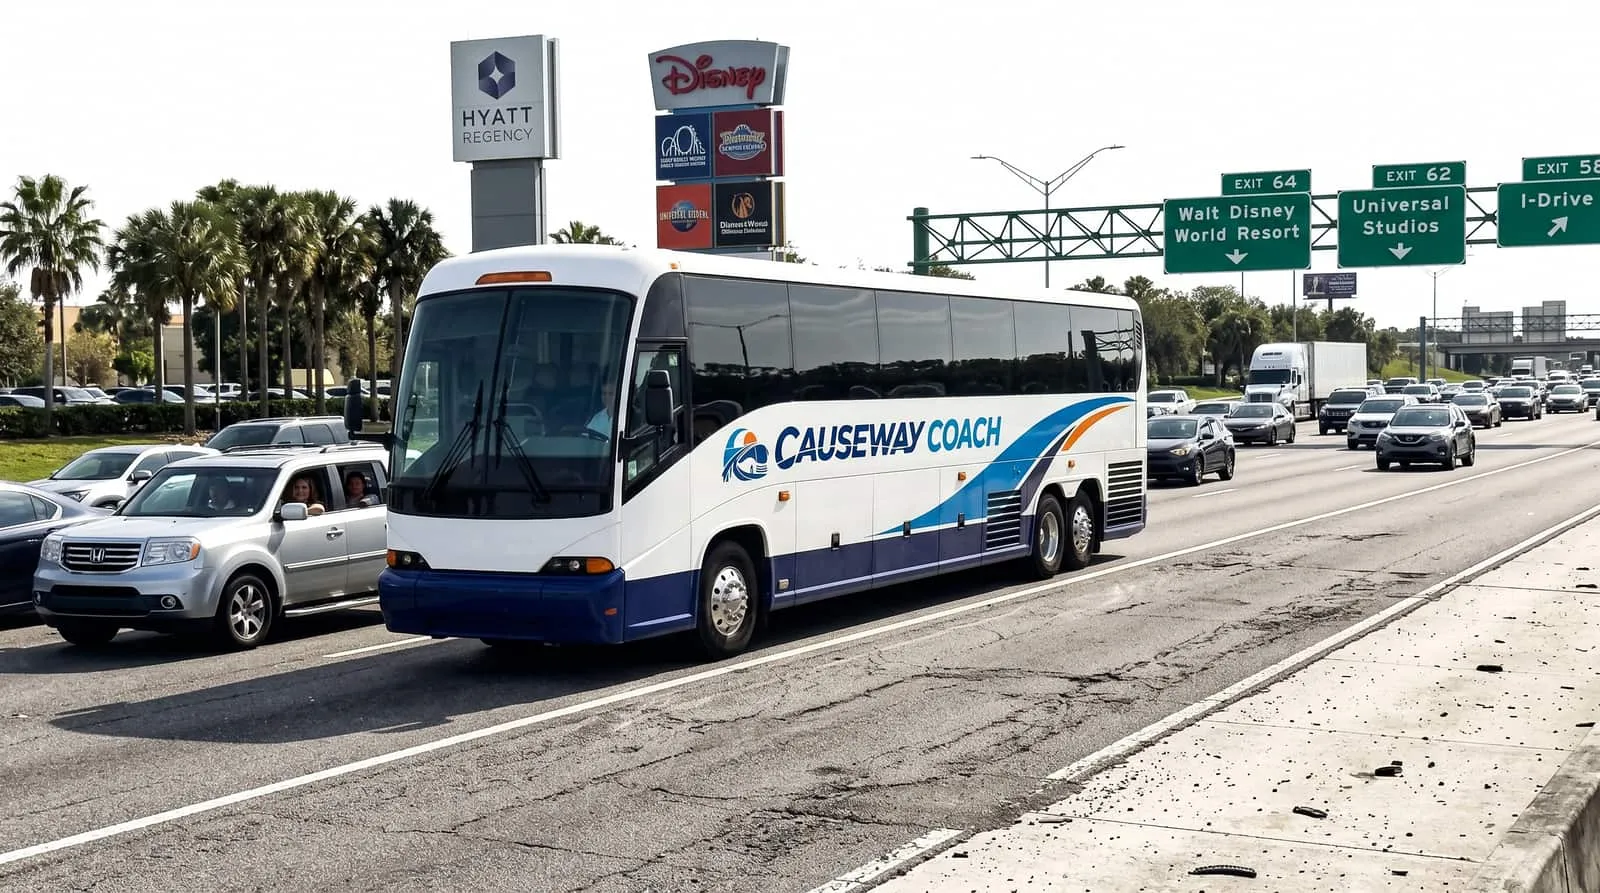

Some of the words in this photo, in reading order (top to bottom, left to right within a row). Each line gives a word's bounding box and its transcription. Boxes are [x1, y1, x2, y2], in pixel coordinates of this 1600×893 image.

[656, 54, 766, 100] Disney
[462, 106, 533, 127] HYATT
[463, 127, 533, 144] REGENCY
[1386, 170, 1417, 182] EXIT
[1426, 167, 1451, 181] 62
[1537, 163, 1569, 175] EXIT
[1579, 159, 1600, 174] 58
[1235, 178, 1263, 190] EXIT
[1272, 175, 1297, 189] 64
[1352, 196, 1449, 214] Universal
[1521, 191, 1594, 209] I-Drive
[1179, 206, 1220, 221] Walt
[1229, 204, 1295, 221] Disney
[1174, 227, 1227, 243] World
[1237, 224, 1300, 241] Resort
[1363, 219, 1440, 236] Studios
[774, 420, 926, 470] CAUSEWAY
[927, 415, 1002, 453] COACH
